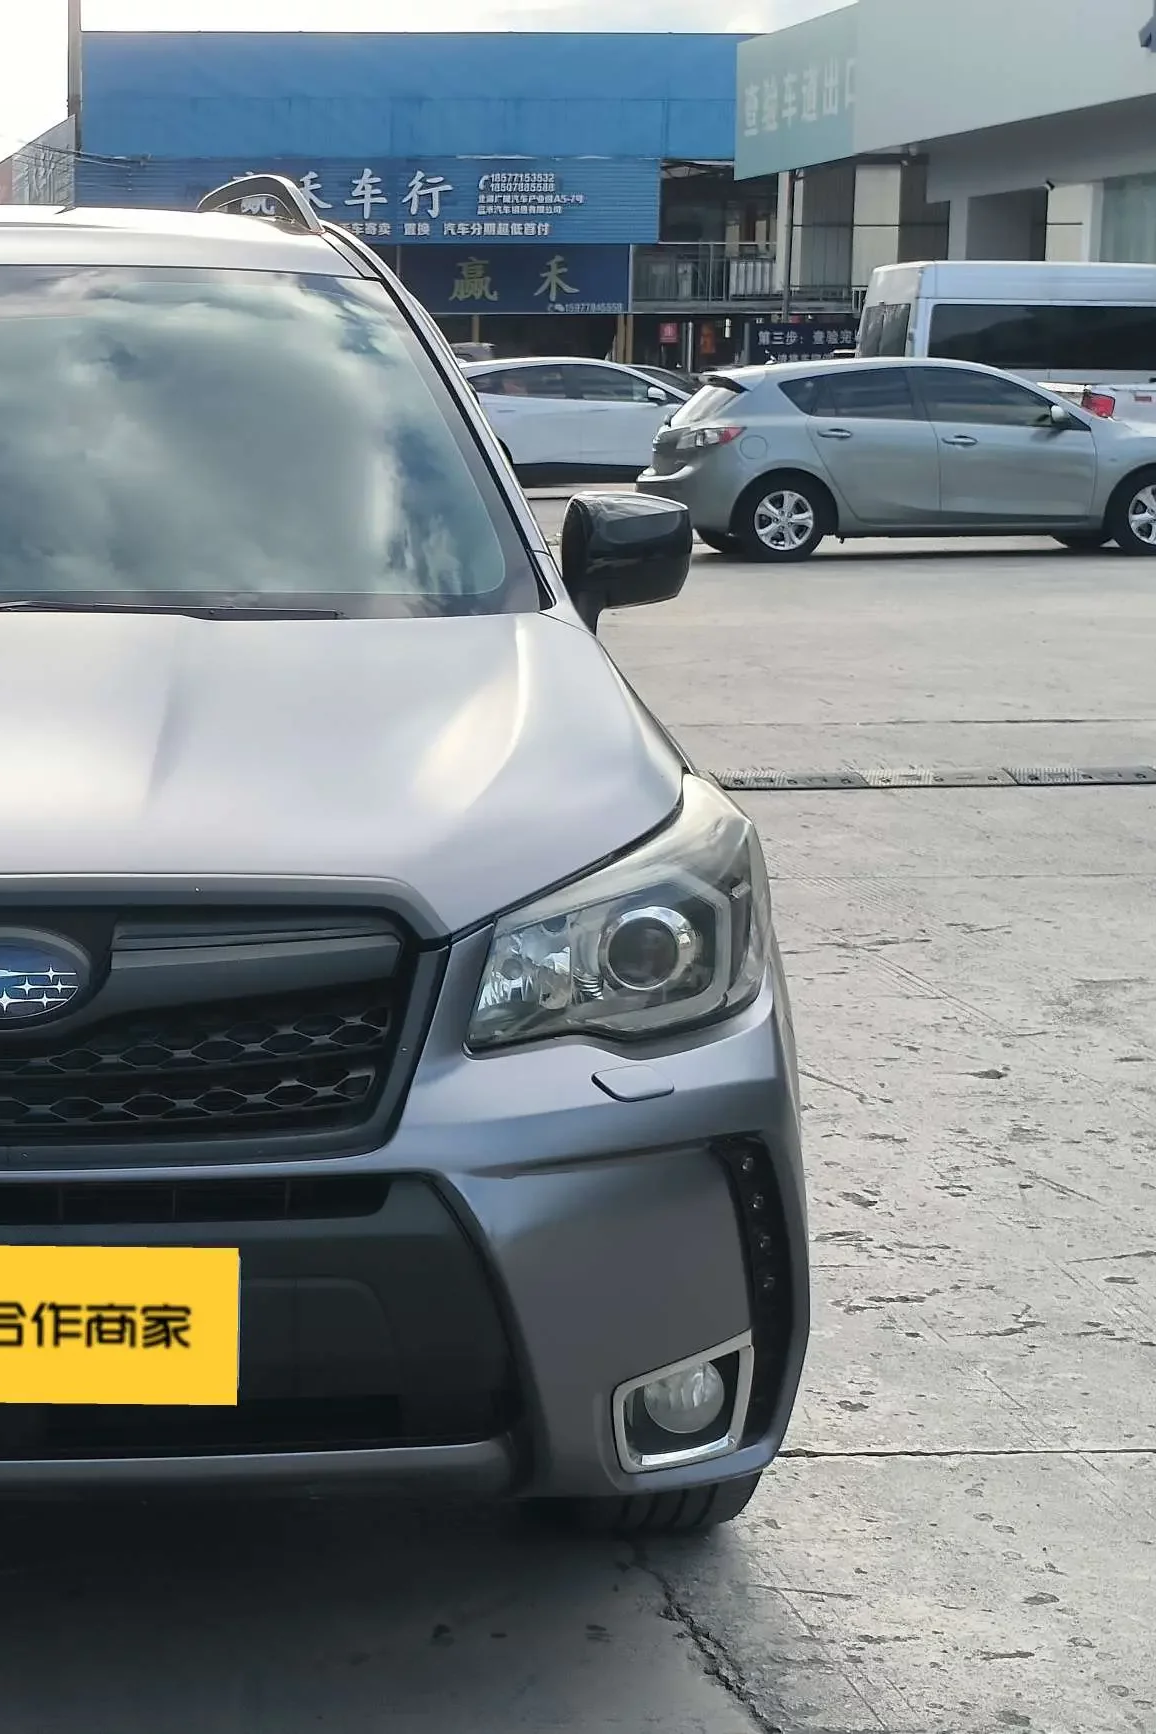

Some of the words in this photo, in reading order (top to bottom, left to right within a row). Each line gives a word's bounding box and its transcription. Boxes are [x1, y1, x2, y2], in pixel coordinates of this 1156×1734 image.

[444, 222, 550, 236] 汽车分期超低首付
